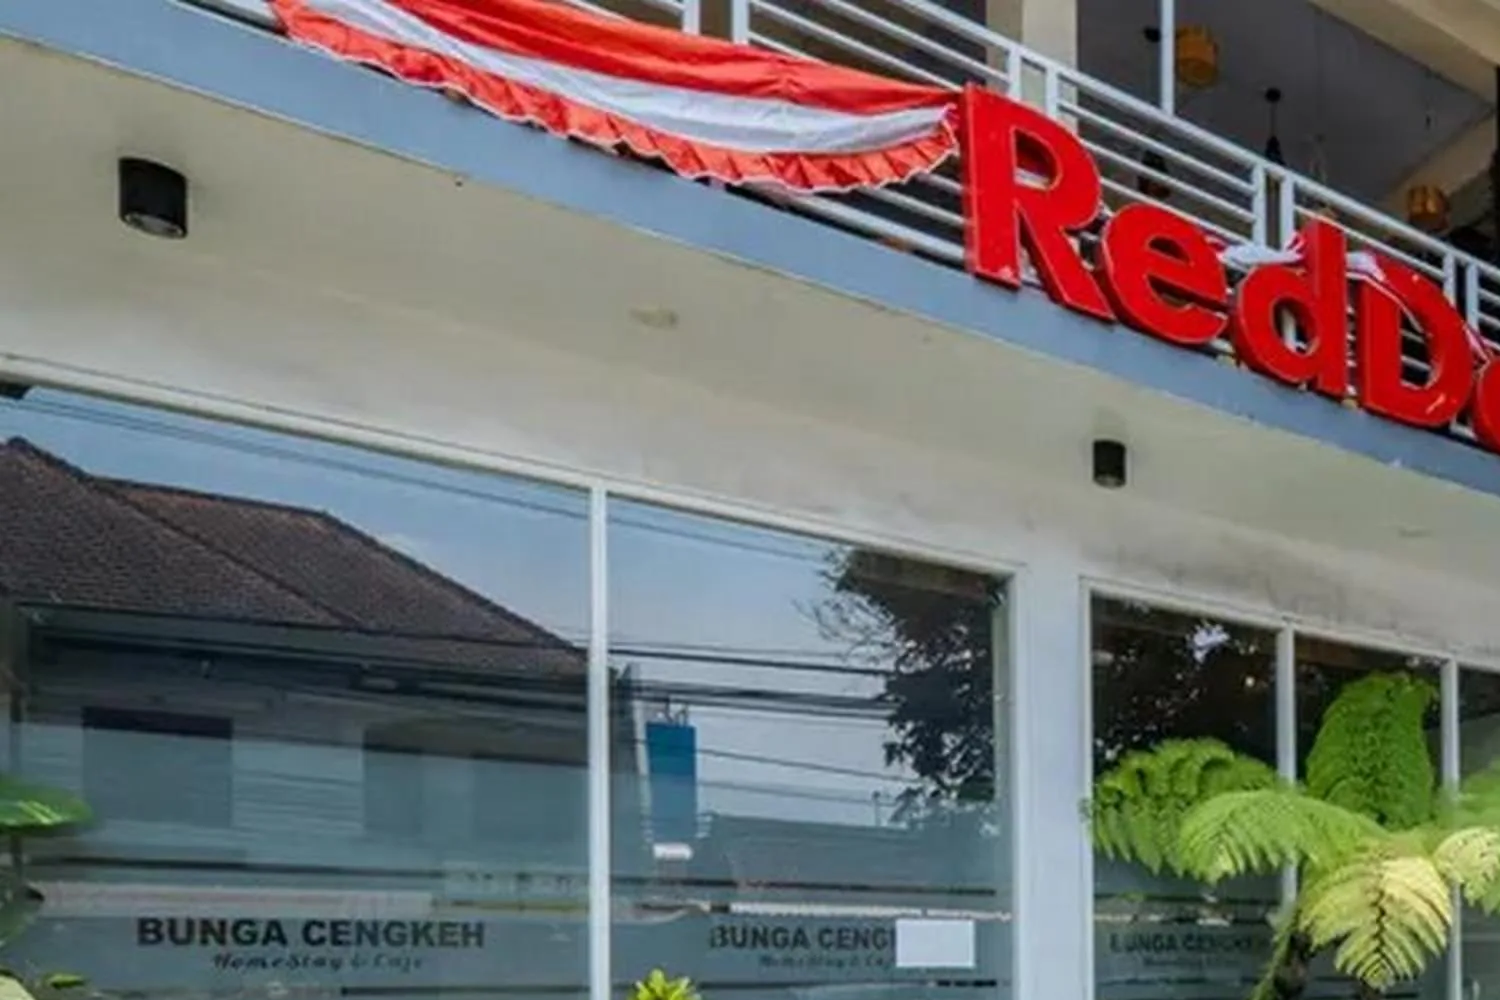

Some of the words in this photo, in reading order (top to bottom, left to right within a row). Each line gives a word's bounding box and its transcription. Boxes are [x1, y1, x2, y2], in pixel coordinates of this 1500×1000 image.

[137, 917, 288, 947] BUNGA
[302, 919, 486, 948] CENGKEH
[710, 925, 812, 949] BUNGA
[817, 927, 897, 951] CENG
